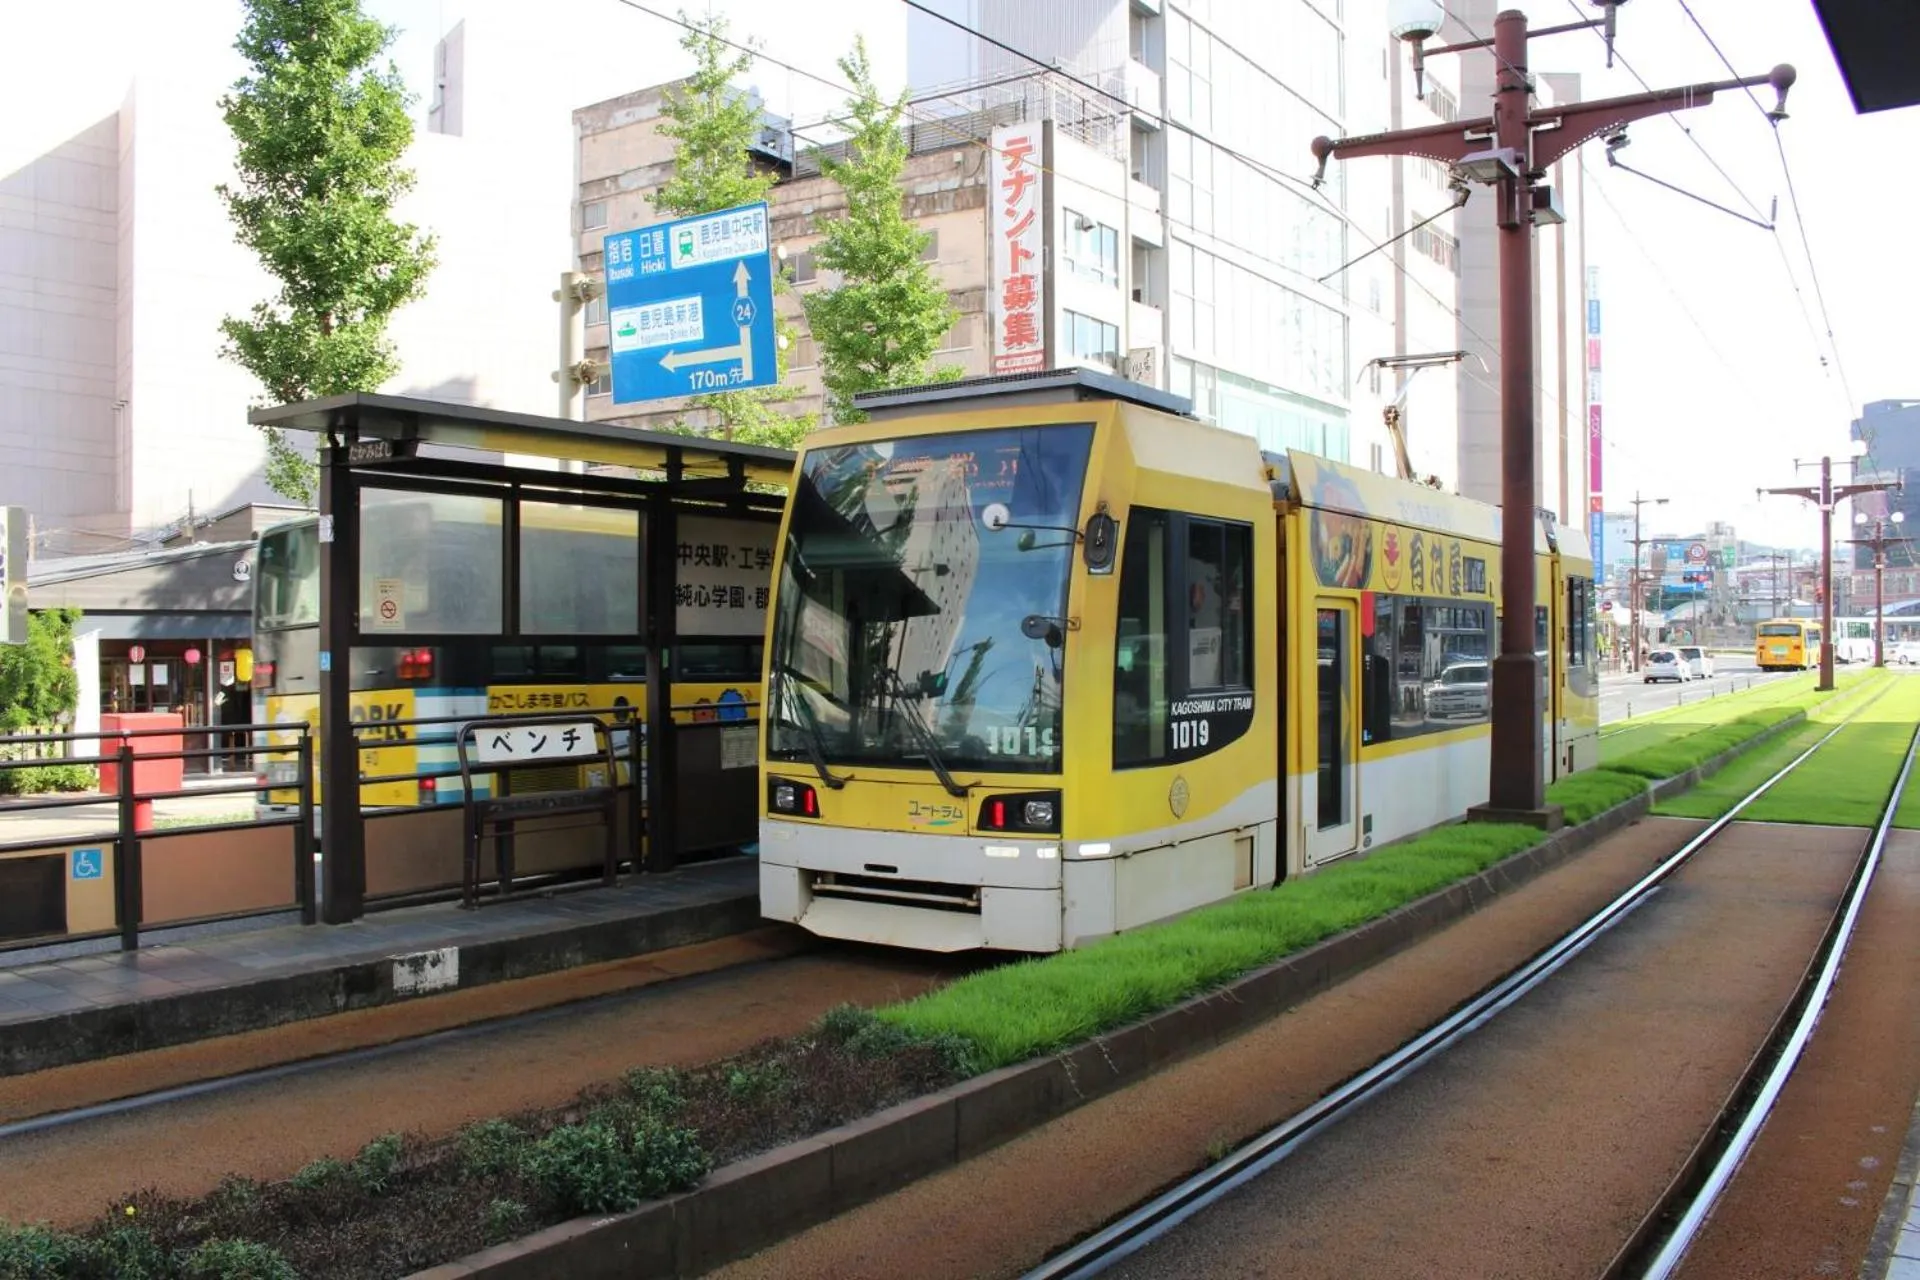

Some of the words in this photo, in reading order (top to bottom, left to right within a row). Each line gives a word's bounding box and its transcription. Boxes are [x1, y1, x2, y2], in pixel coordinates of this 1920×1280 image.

[640, 230, 665, 258] 日置
[1002, 136, 1037, 350] テナント募集
[736, 303, 752, 321] 24
[689, 367, 744, 390] 170m先
[489, 692, 590, 709] かごしま市営バス
[1171, 700, 1216, 716] KAGOSHIMA
[1217, 698, 1233, 713] CITY
[1233, 696, 1253, 711] TRAM
[492, 727, 581, 753] ベンチ
[1171, 719, 1209, 750] 1019
[908, 800, 964, 819] ユートラム
